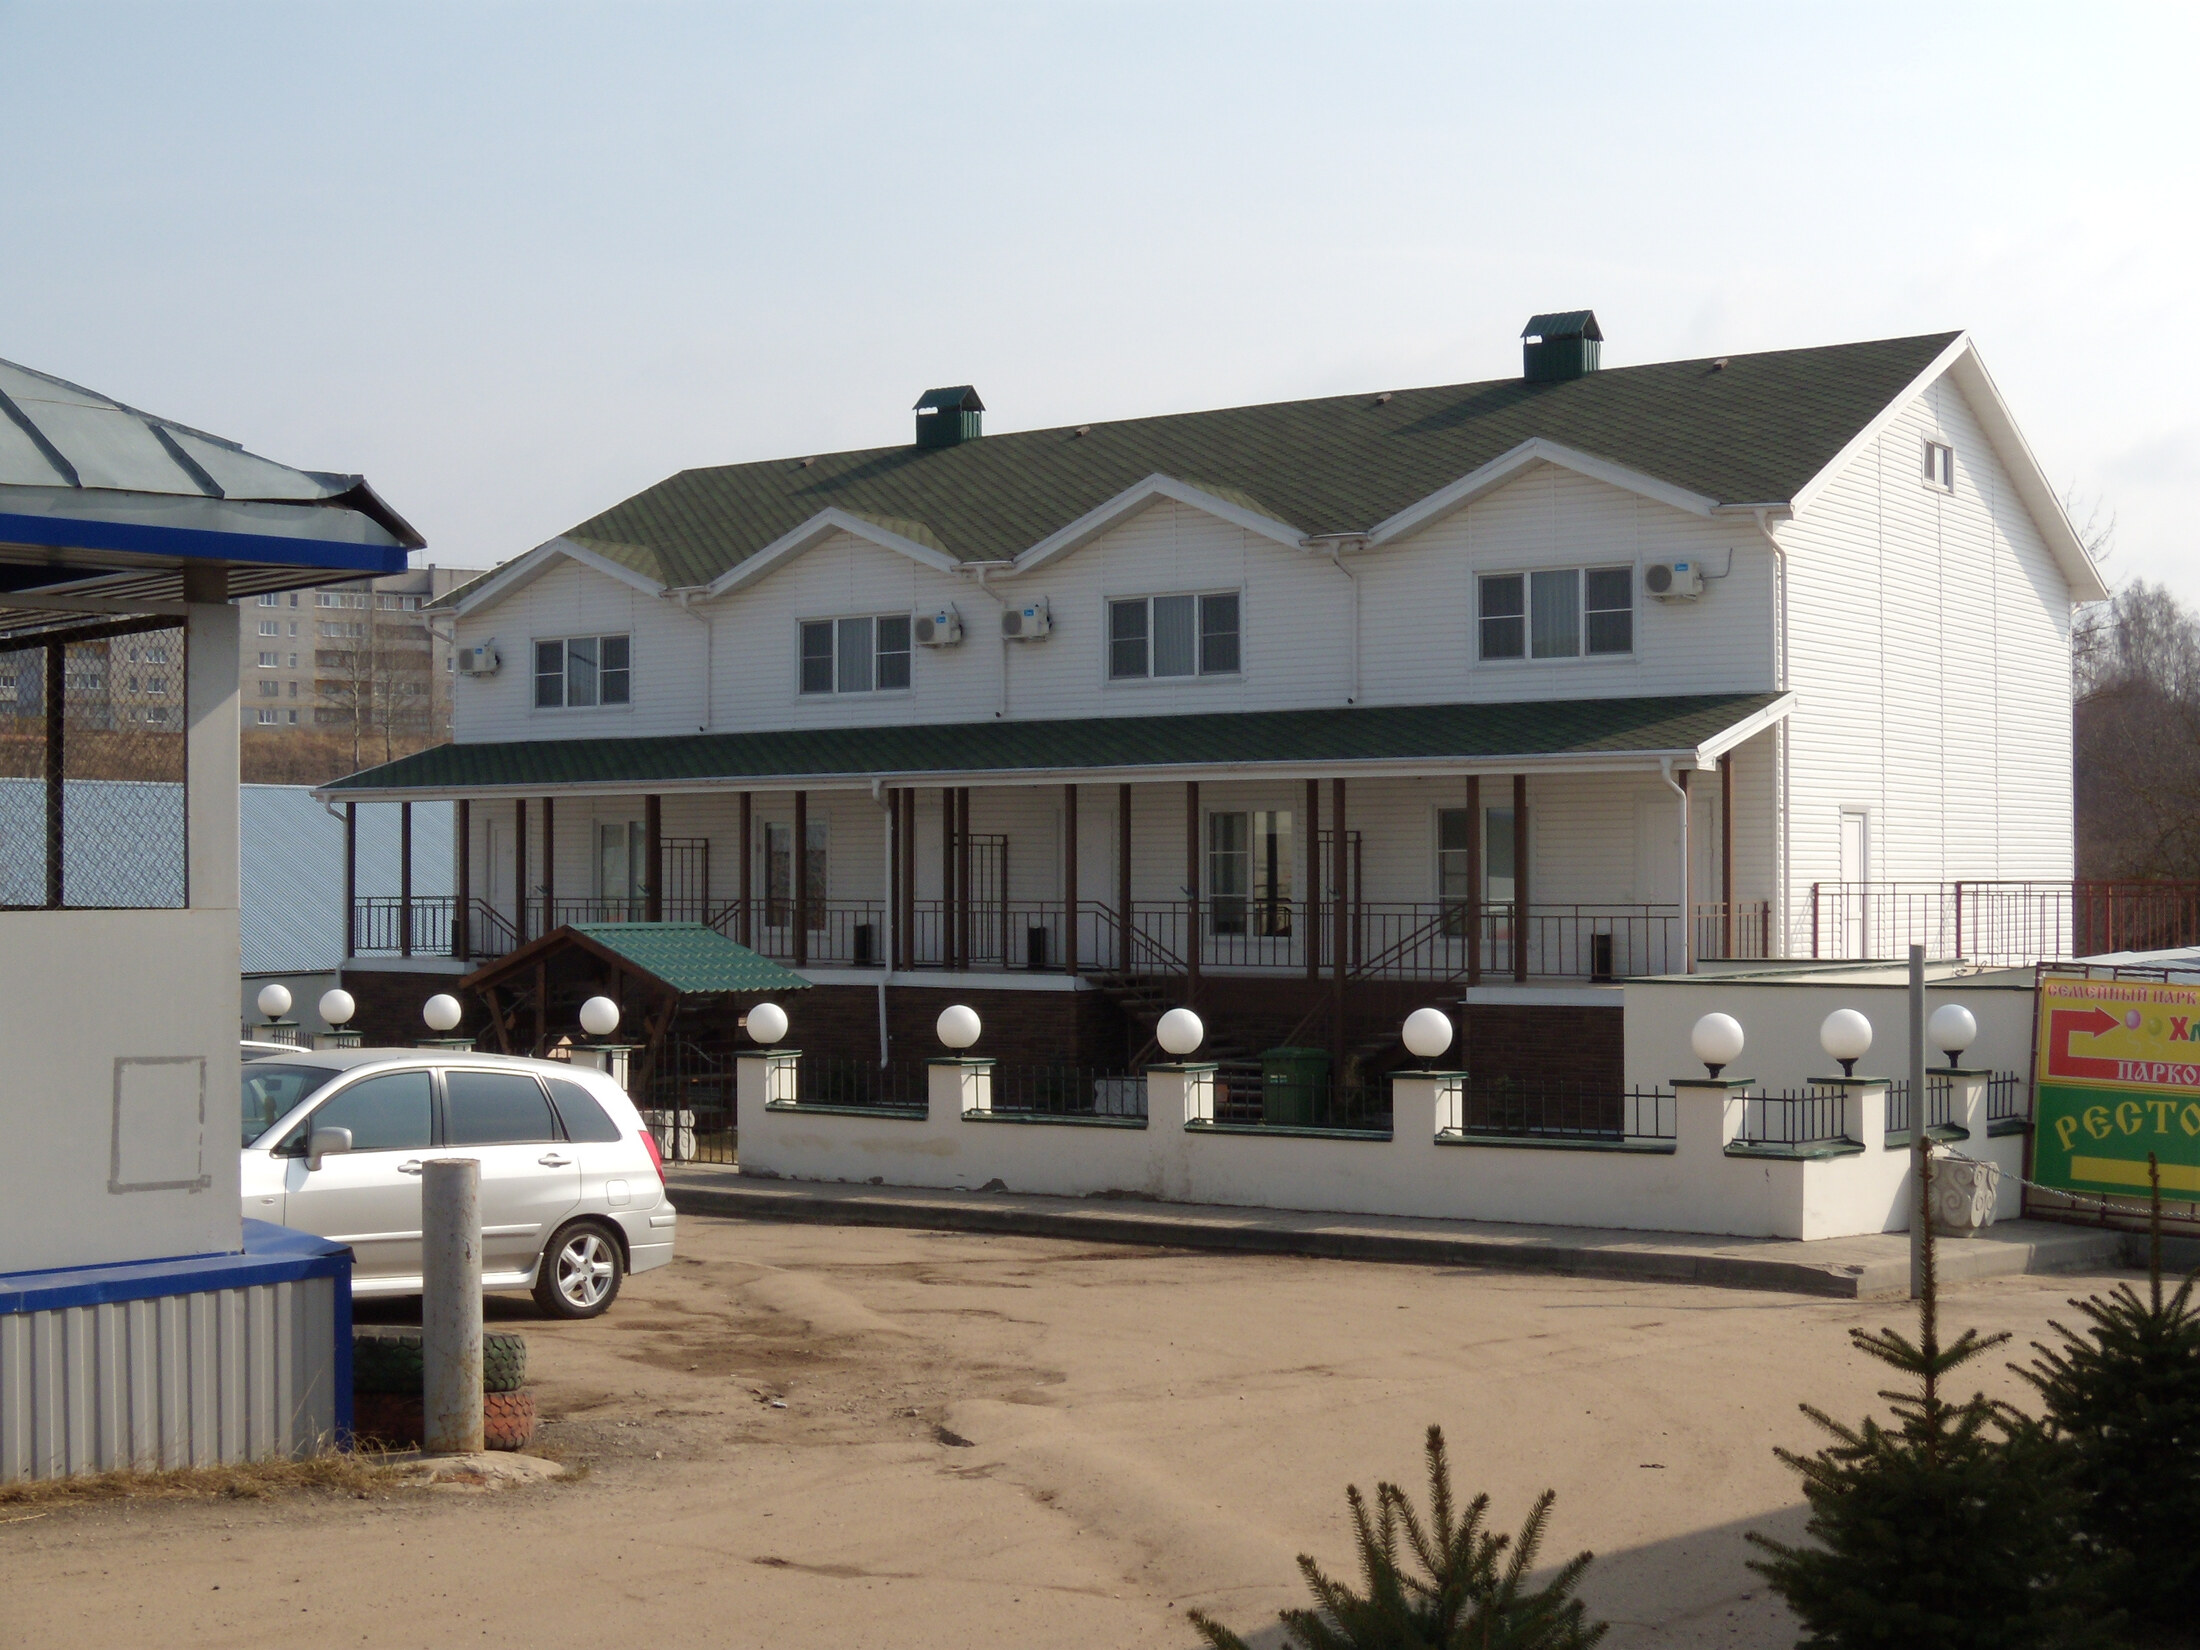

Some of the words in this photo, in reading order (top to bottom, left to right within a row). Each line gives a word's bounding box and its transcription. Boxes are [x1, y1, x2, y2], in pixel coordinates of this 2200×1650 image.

[2047, 984, 2148, 1002] СЕМЕЙНЫЙ
[2117, 1061, 2200, 1084] ПАРКО
[2055, 1100, 2200, 1152] РЕСТО
